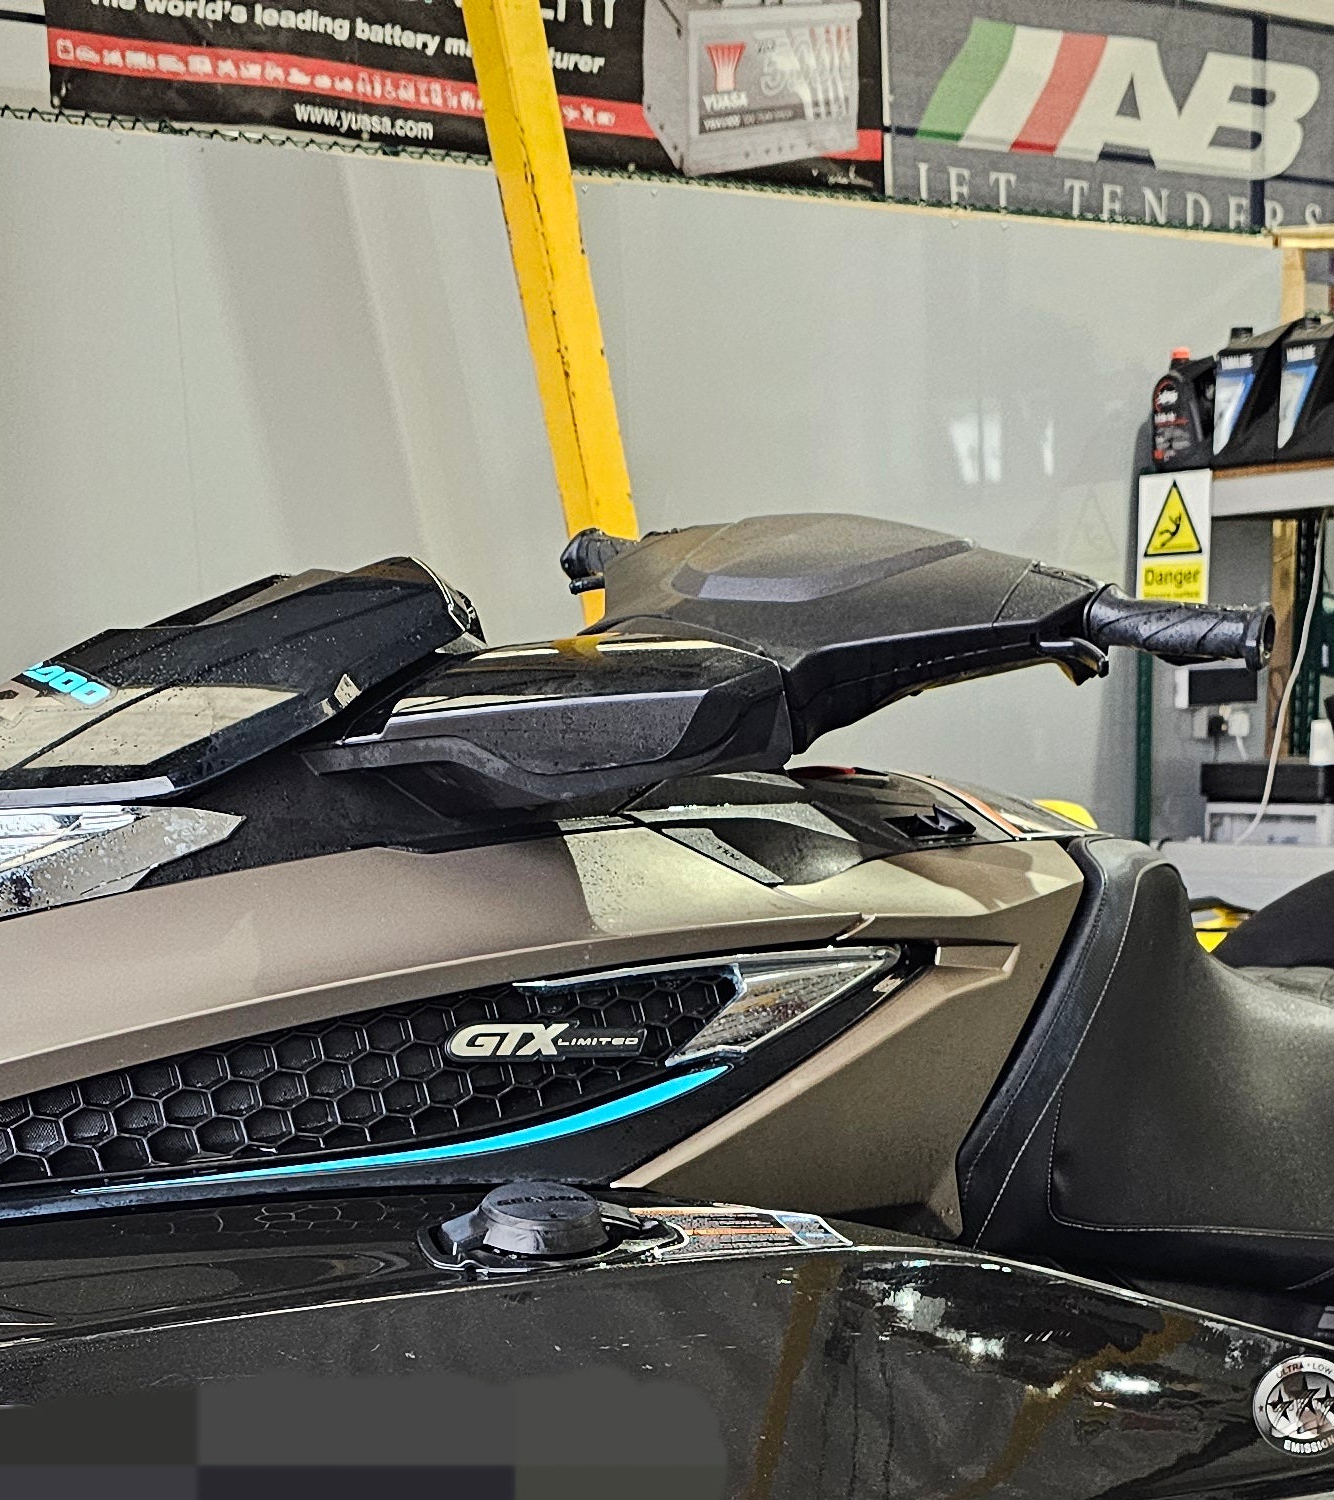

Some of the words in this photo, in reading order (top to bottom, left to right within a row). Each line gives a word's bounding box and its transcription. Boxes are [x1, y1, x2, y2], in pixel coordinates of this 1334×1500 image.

[254, 3, 350, 41] leading
[355, 17, 441, 56] battery
[293, 102, 434, 141] www.yuasa.com
[1064, 178, 1324, 232] TENDERS
[1144, 567, 1202, 588] Danger
[449, 1023, 570, 1057] GTX
[557, 1037, 639, 1047] LIMITED
